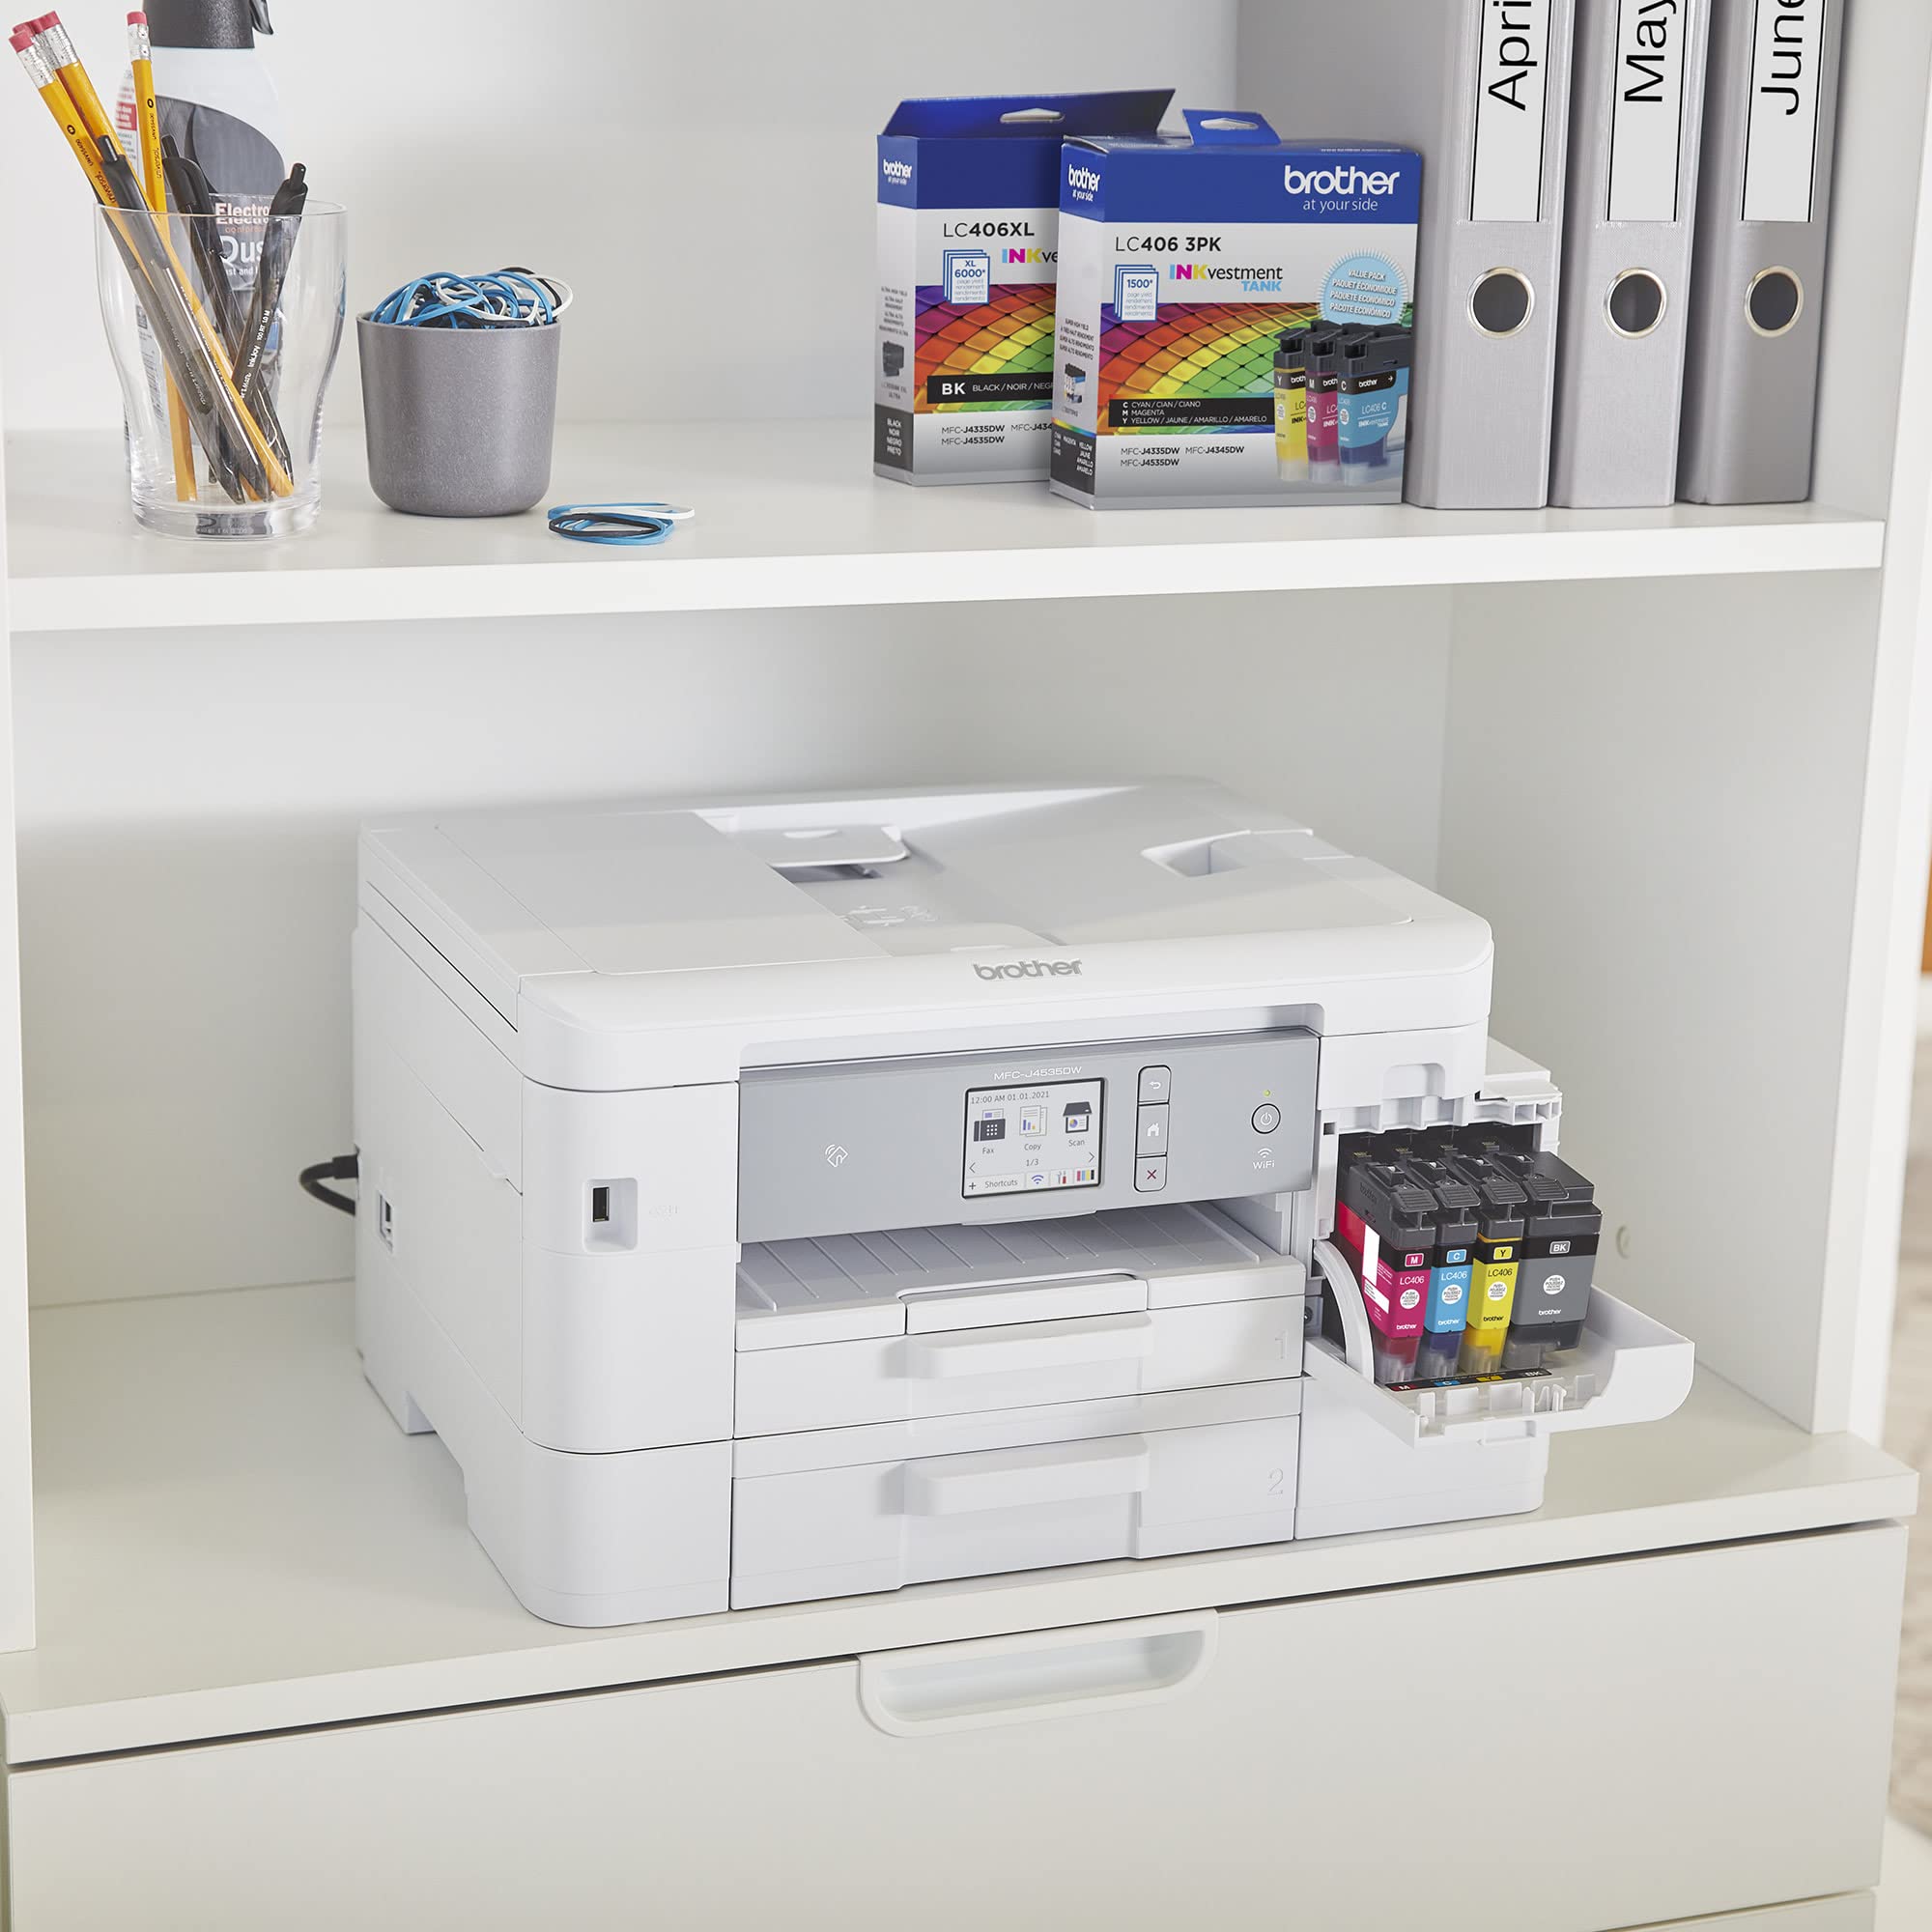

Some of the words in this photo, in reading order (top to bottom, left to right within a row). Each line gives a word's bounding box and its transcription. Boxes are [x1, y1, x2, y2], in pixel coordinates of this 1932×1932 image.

[883, 158, 913, 179] brother
[1068, 164, 1100, 191] brother
[1284, 165, 1401, 195] brother
[1303, 199, 1316, 211] at
[1320, 200, 1350, 213] your
[1352, 198, 1378, 211] side
[943, 222, 1035, 238] LC406XL
[1116, 237, 1179, 252] LC406
[1184, 237, 1222, 252] 3PK
[1169, 264, 1283, 280] INKvestment
[1348, 269, 1368, 279] VALUE
[1368, 271, 1386, 282] PACK
[1241, 280, 1282, 292] TANK
[1277, 376, 1283, 386] Y
[1341, 381, 1347, 391] C
[1358, 379, 1378, 388] brother
[942, 383, 966, 395] BK
[972, 384, 1000, 392] BLACK
[1007, 383, 1027, 391] NOIR
[1294, 401, 1306, 411] LC
[1381, 402, 1387, 411] C
[942, 425, 1006, 435] MFC-J4335DW
[942, 436, 1005, 445] MFC-J4535DW
[1121, 447, 1180, 456] MFC-J4335DW
[1120, 459, 1180, 468] MFC-J4535DW
[973, 959, 1082, 980] brother
[993, 1066, 1083, 1080] MFC-J4535DW
[971, 1095, 993, 1104] 12:00
[1007, 1091, 1050, 1101] 01.01.2021
[1024, 1143, 1042, 1151] Copy
[1068, 1139, 1085, 1148] Scan
[1026, 1158, 1039, 1167] 1/3
[1252, 1159, 1275, 1169] WiFi
[985, 1179, 1018, 1189] Shortcuts
[1553, 1243, 1567, 1252] BK
[1410, 1256, 1418, 1264] M
[1440, 1270, 1467, 1281] LC406
[1488, 1268, 1513, 1277] LC406
[1400, 1275, 1425, 1286] LC406
[1275, 1329, 1290, 1360] 1
[1267, 1467, 1284, 1496] 2
